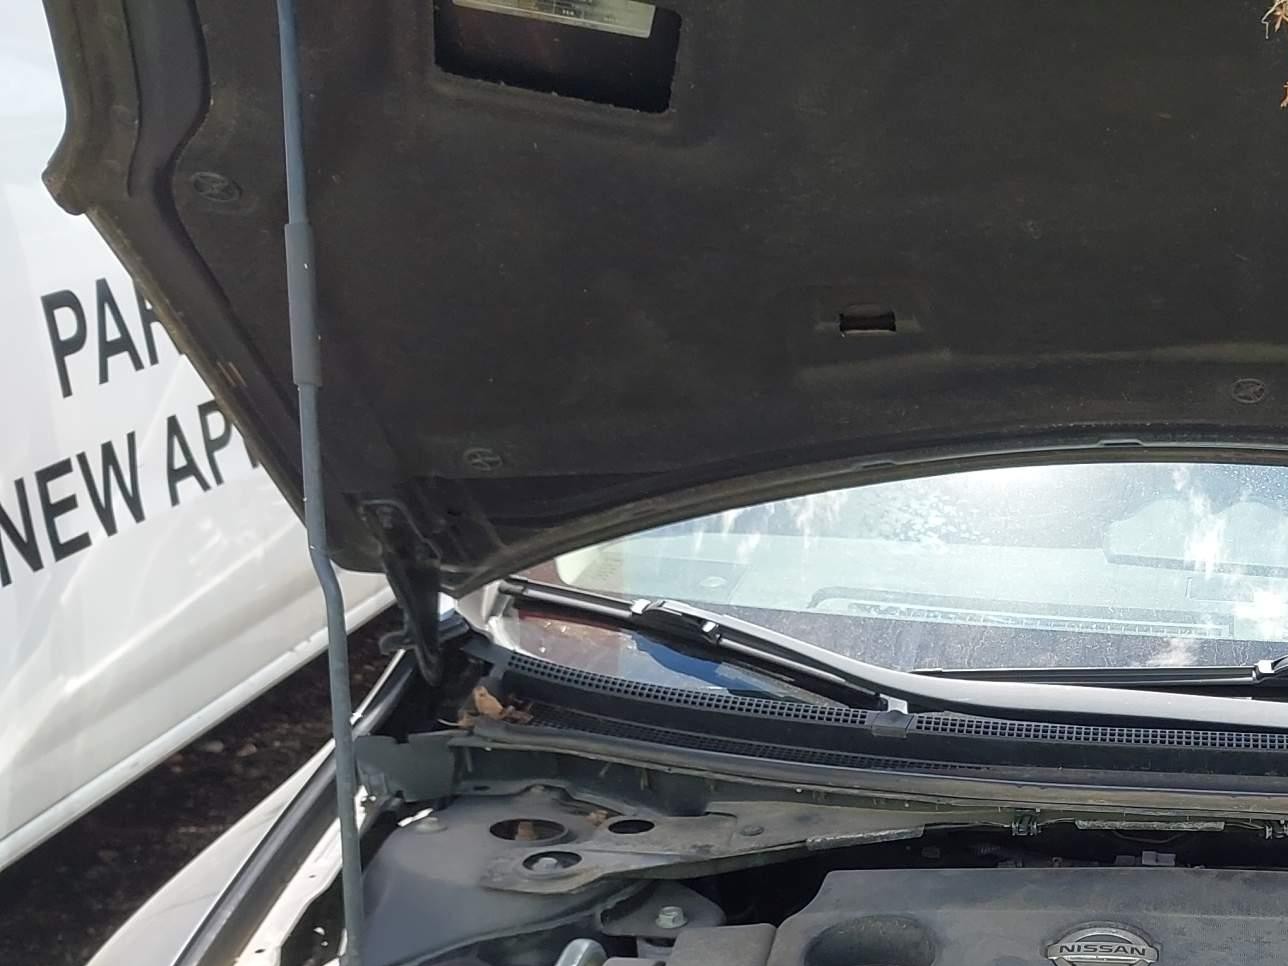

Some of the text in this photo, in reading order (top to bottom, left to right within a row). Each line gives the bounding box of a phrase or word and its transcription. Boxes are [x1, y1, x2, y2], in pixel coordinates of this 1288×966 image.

[0, 398, 258, 587] NEW AP
[1059, 944, 1146, 957] NISSAN
